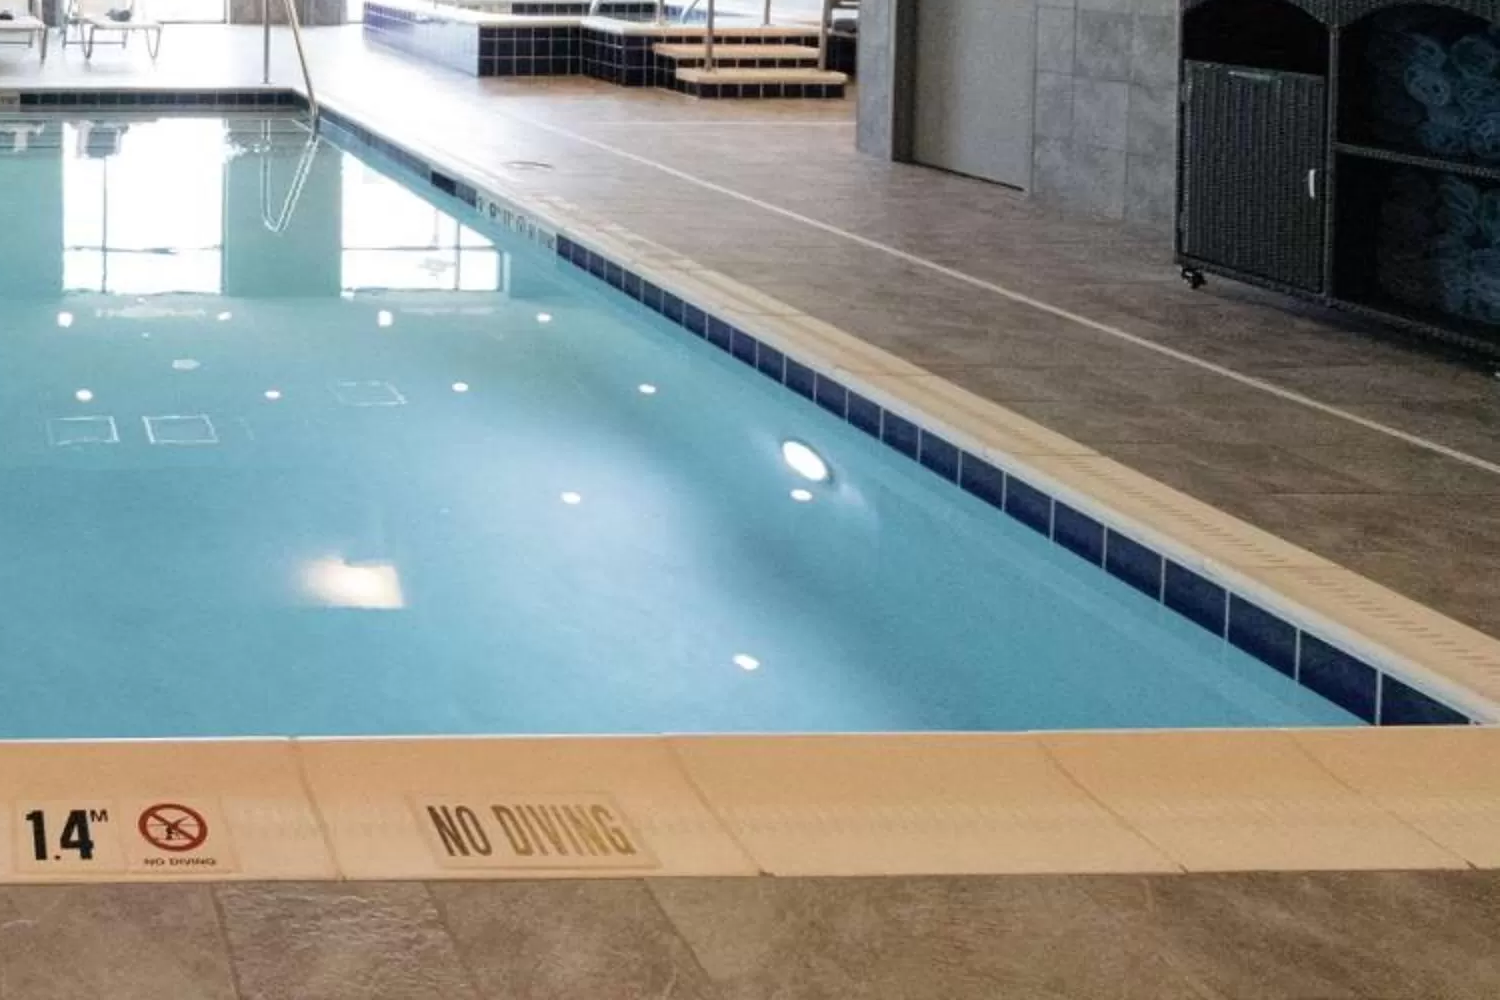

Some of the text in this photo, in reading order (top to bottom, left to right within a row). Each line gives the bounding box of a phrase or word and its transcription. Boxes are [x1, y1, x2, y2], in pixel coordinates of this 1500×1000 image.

[426, 804, 637, 857] NO DIVING
[143, 857, 217, 867] NO DIVING
